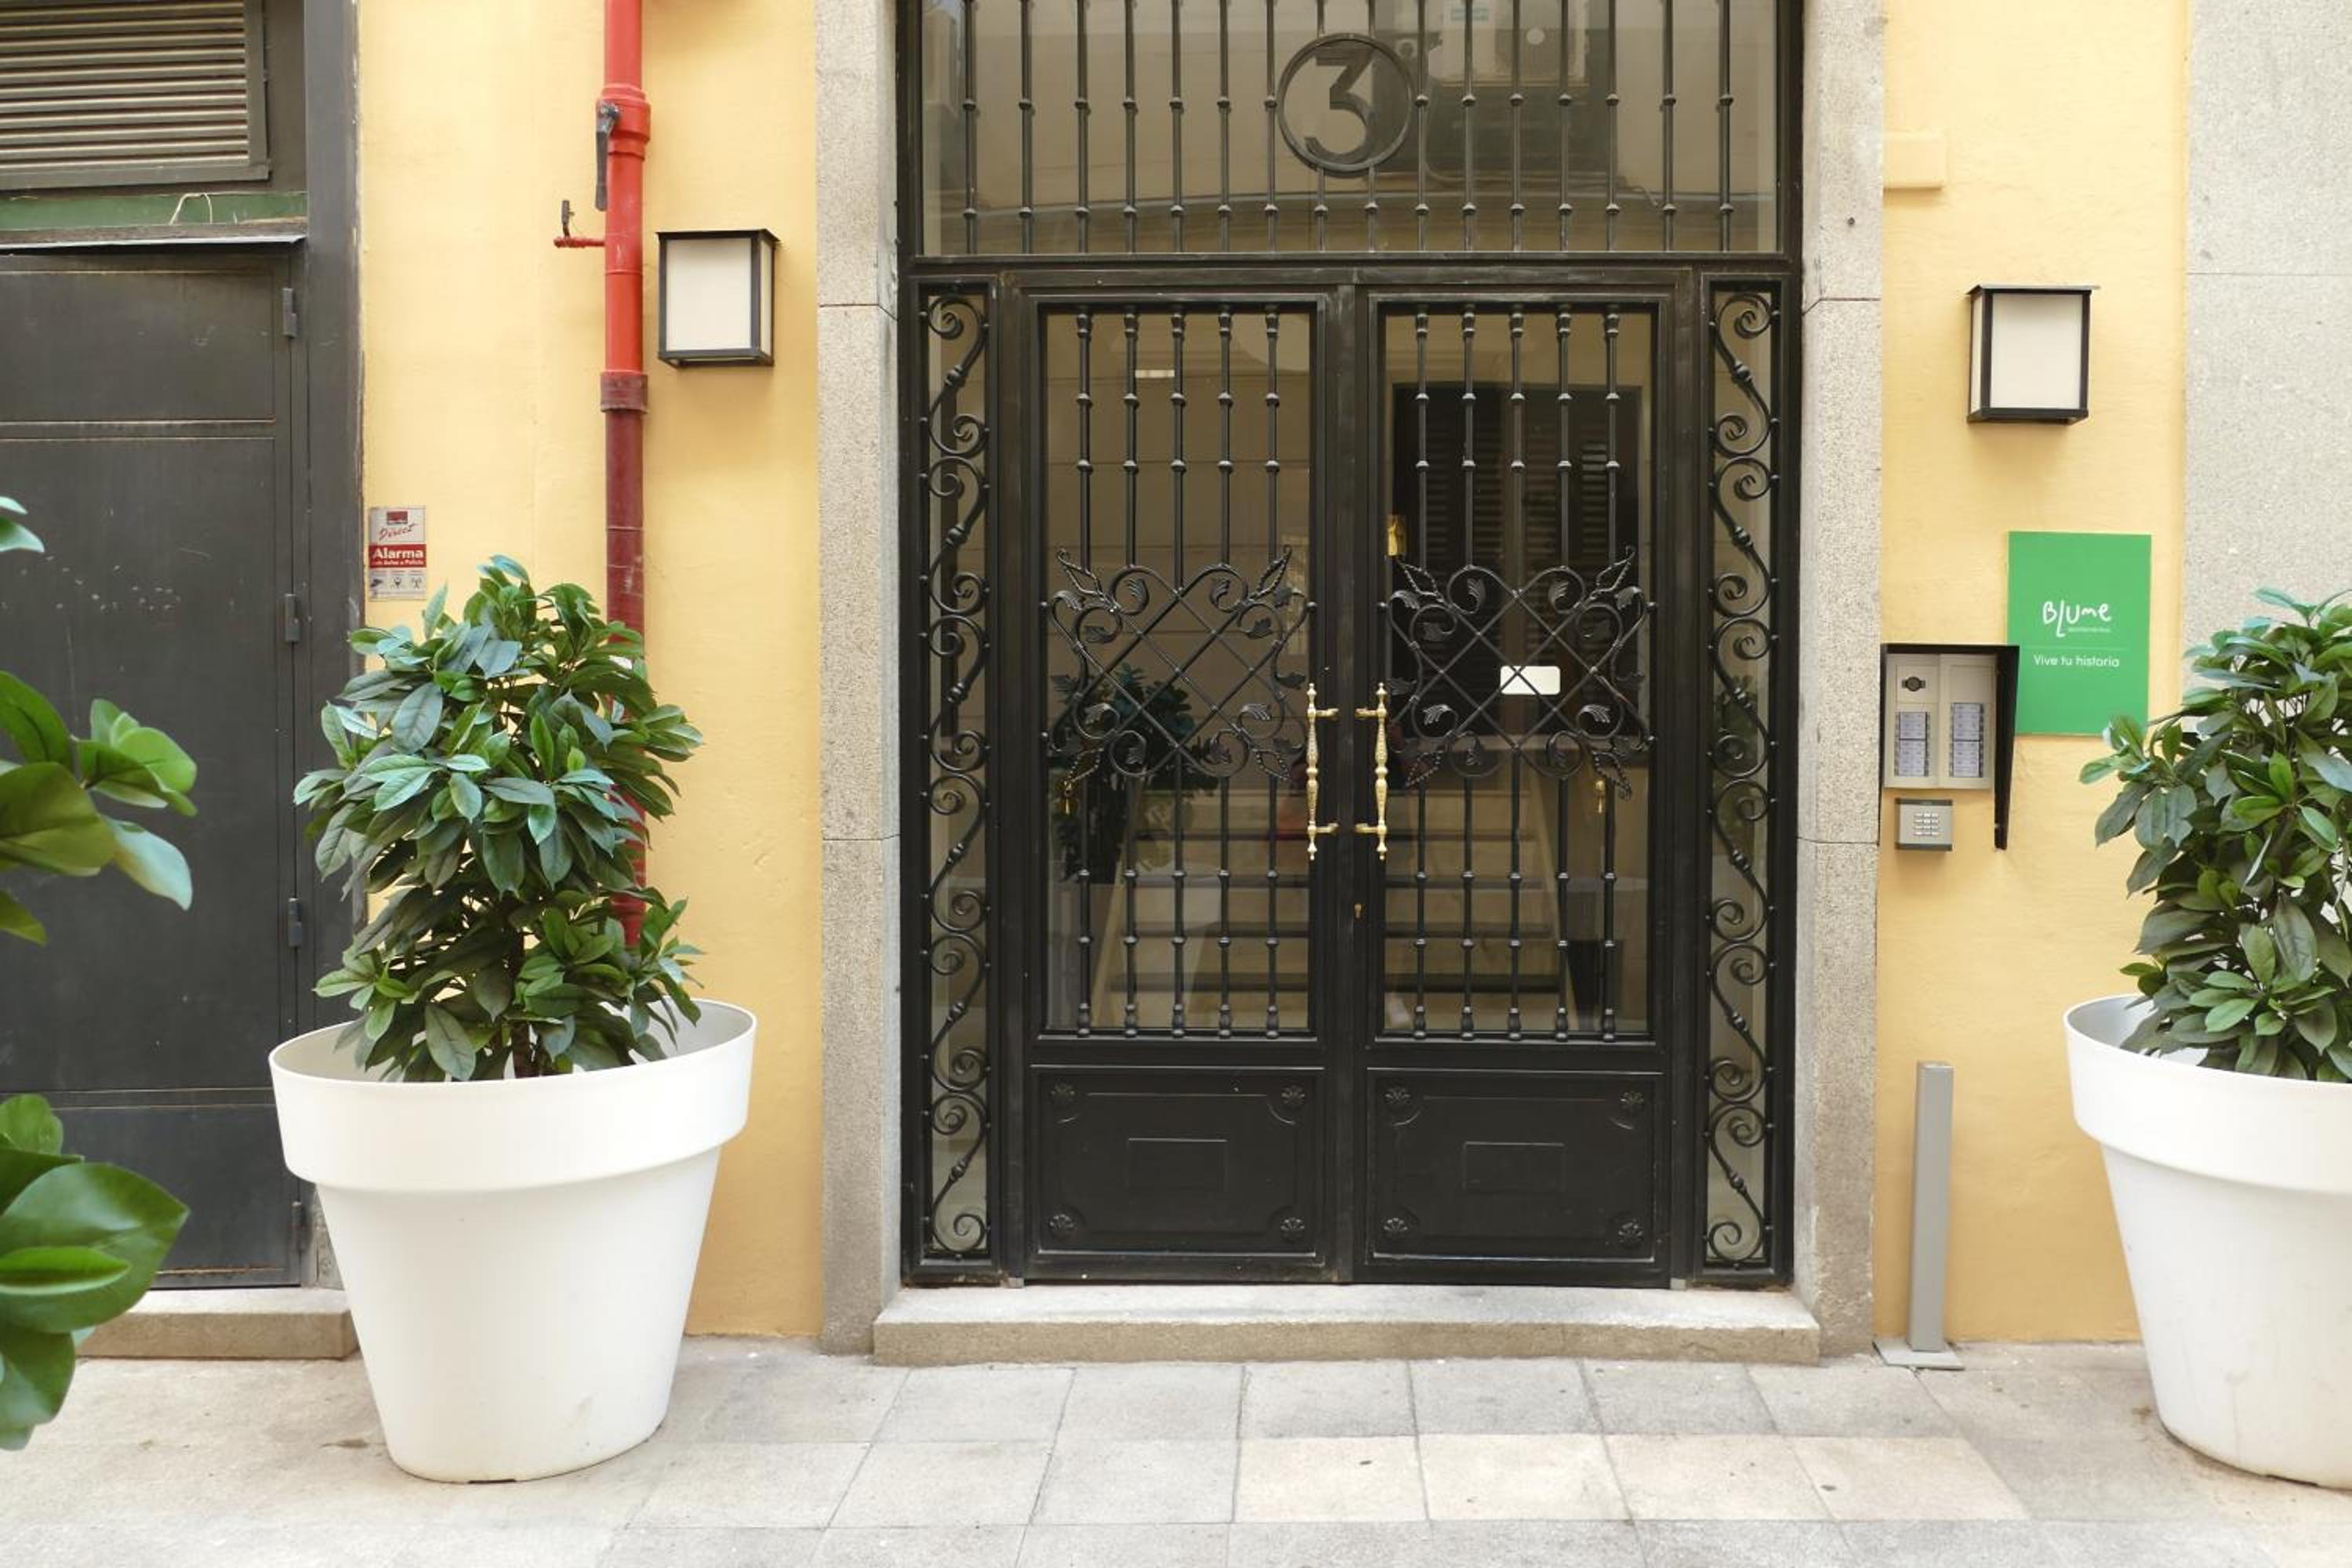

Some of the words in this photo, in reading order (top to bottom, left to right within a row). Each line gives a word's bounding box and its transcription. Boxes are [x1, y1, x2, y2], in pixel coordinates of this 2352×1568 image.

[1304, 43, 1375, 166] 3
[372, 547, 424, 559] Alarma
[2034, 655, 2058, 666] Vive
[2061, 655, 2072, 666] tu
[2075, 655, 2119, 667] historia
